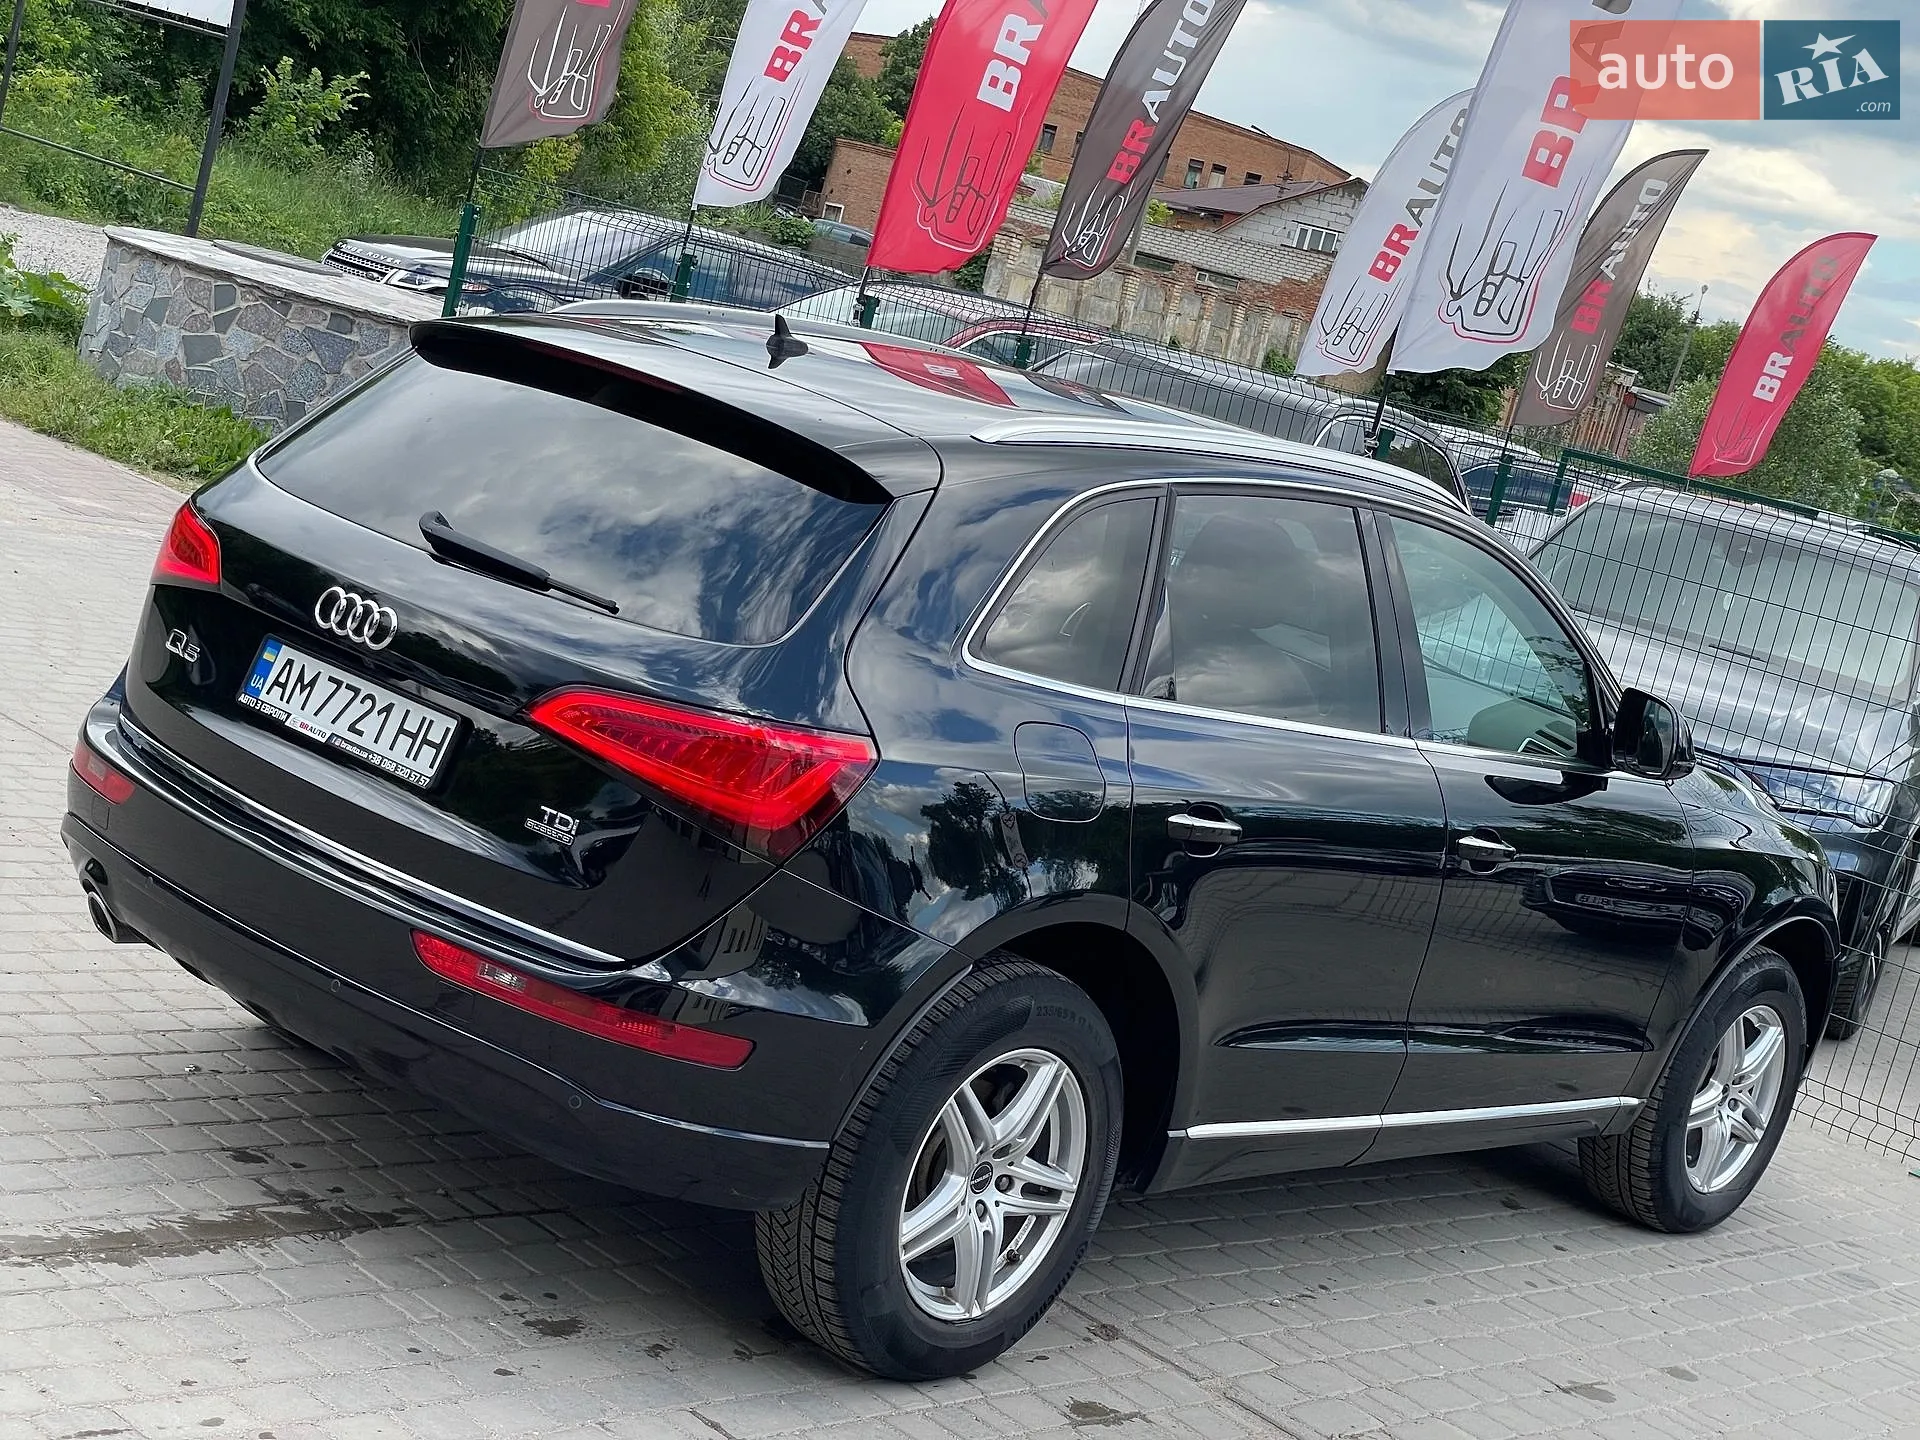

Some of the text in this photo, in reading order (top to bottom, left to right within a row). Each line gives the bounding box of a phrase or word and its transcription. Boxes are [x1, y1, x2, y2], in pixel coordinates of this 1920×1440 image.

[763, 0, 828, 82] BR
[976, 0, 1048, 112] BR
[1106, 0, 1216, 184] BRAUTO
[1522, 0, 1633, 188] BRA
[336, 241, 401, 265] RANGE ROVER
[1571, 178, 1669, 335] BRAUTO
[1753, 255, 1839, 403] BRAUTO
[165, 628, 200, 662] Q5
[250, 674, 264, 690] UA
[299, 721, 327, 739] BRAUTO
[313, 675, 396, 745] 7721
[540, 805, 580, 836] TDI
